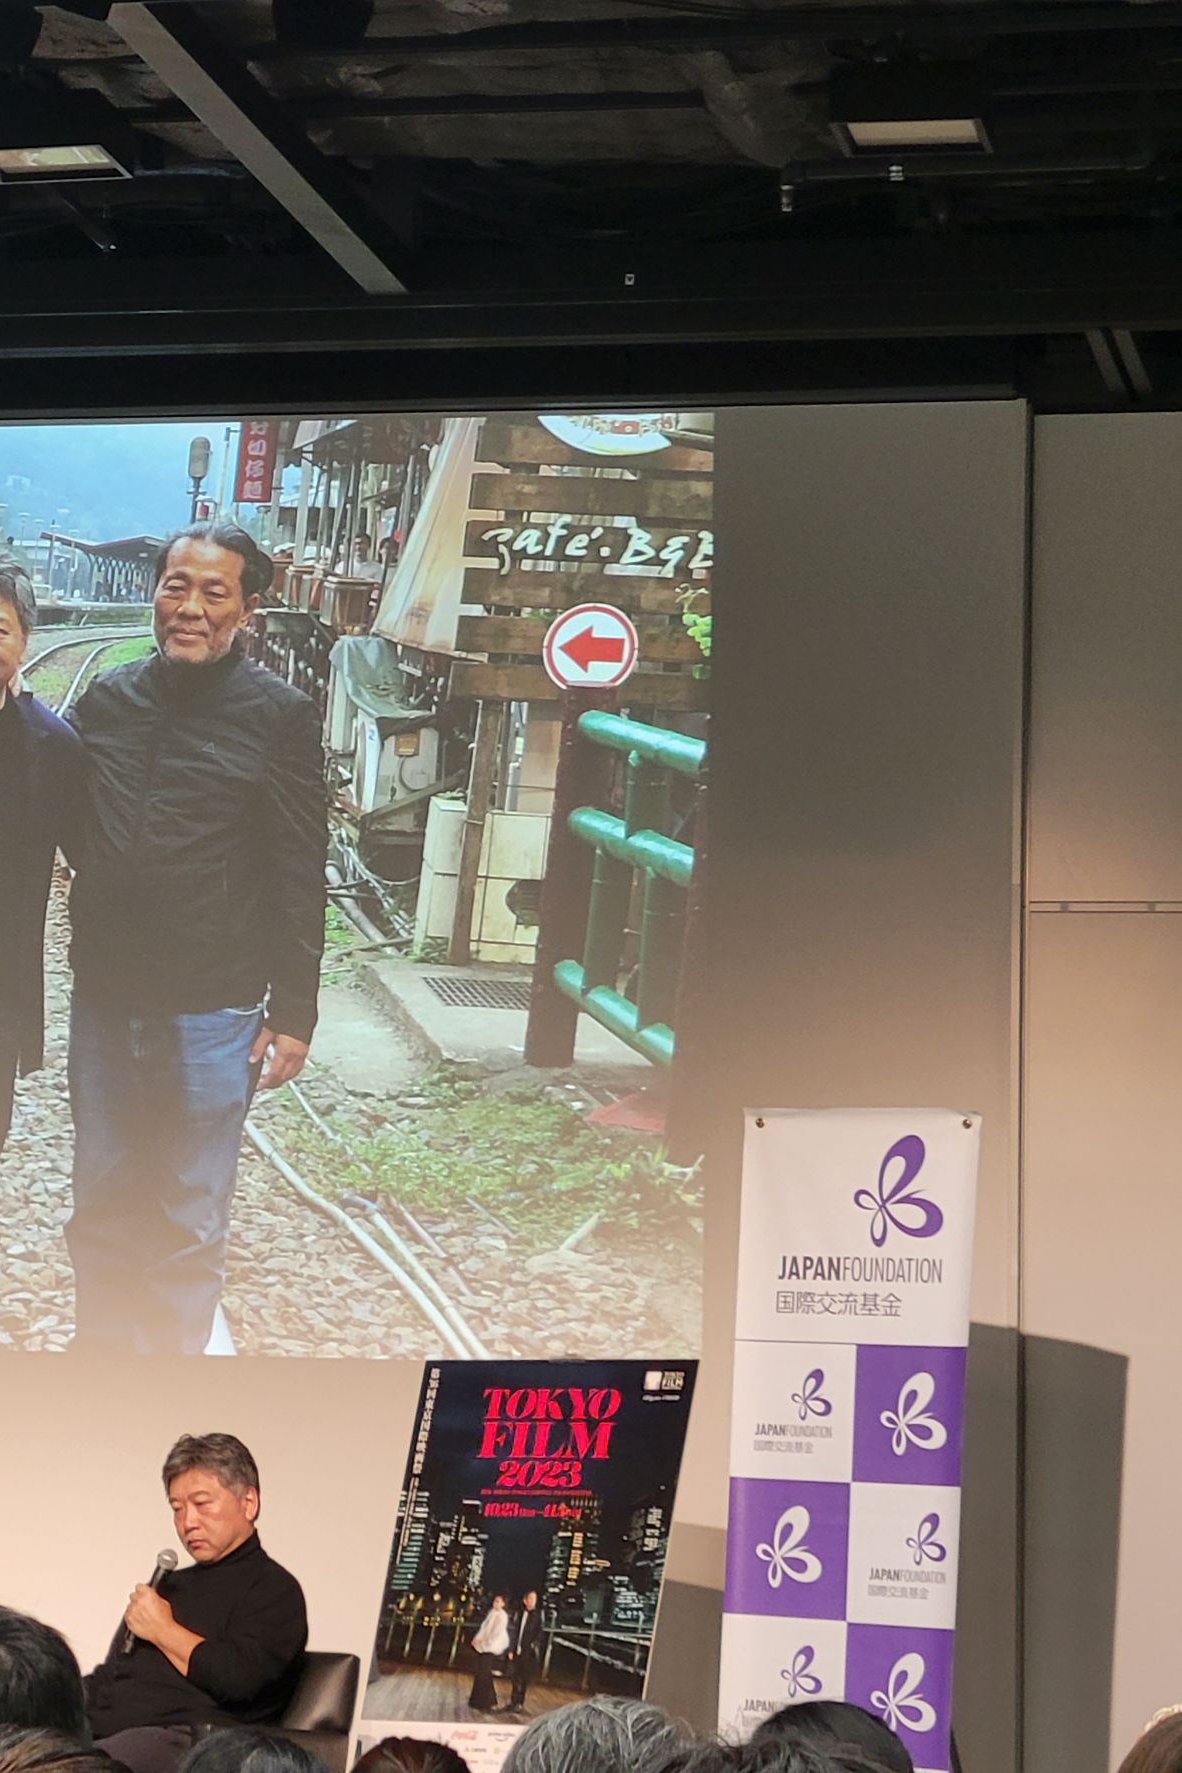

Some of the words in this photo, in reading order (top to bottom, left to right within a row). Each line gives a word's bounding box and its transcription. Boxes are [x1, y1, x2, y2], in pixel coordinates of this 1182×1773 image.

[777, 1255, 944, 1284] JAPANFOUNDATION
[775, 1291, 903, 1318] 国際交流基金
[482, 1388, 623, 1420] TOKYO
[475, 1421, 617, 1459] FILM
[495, 1460, 583, 1488] 2023
